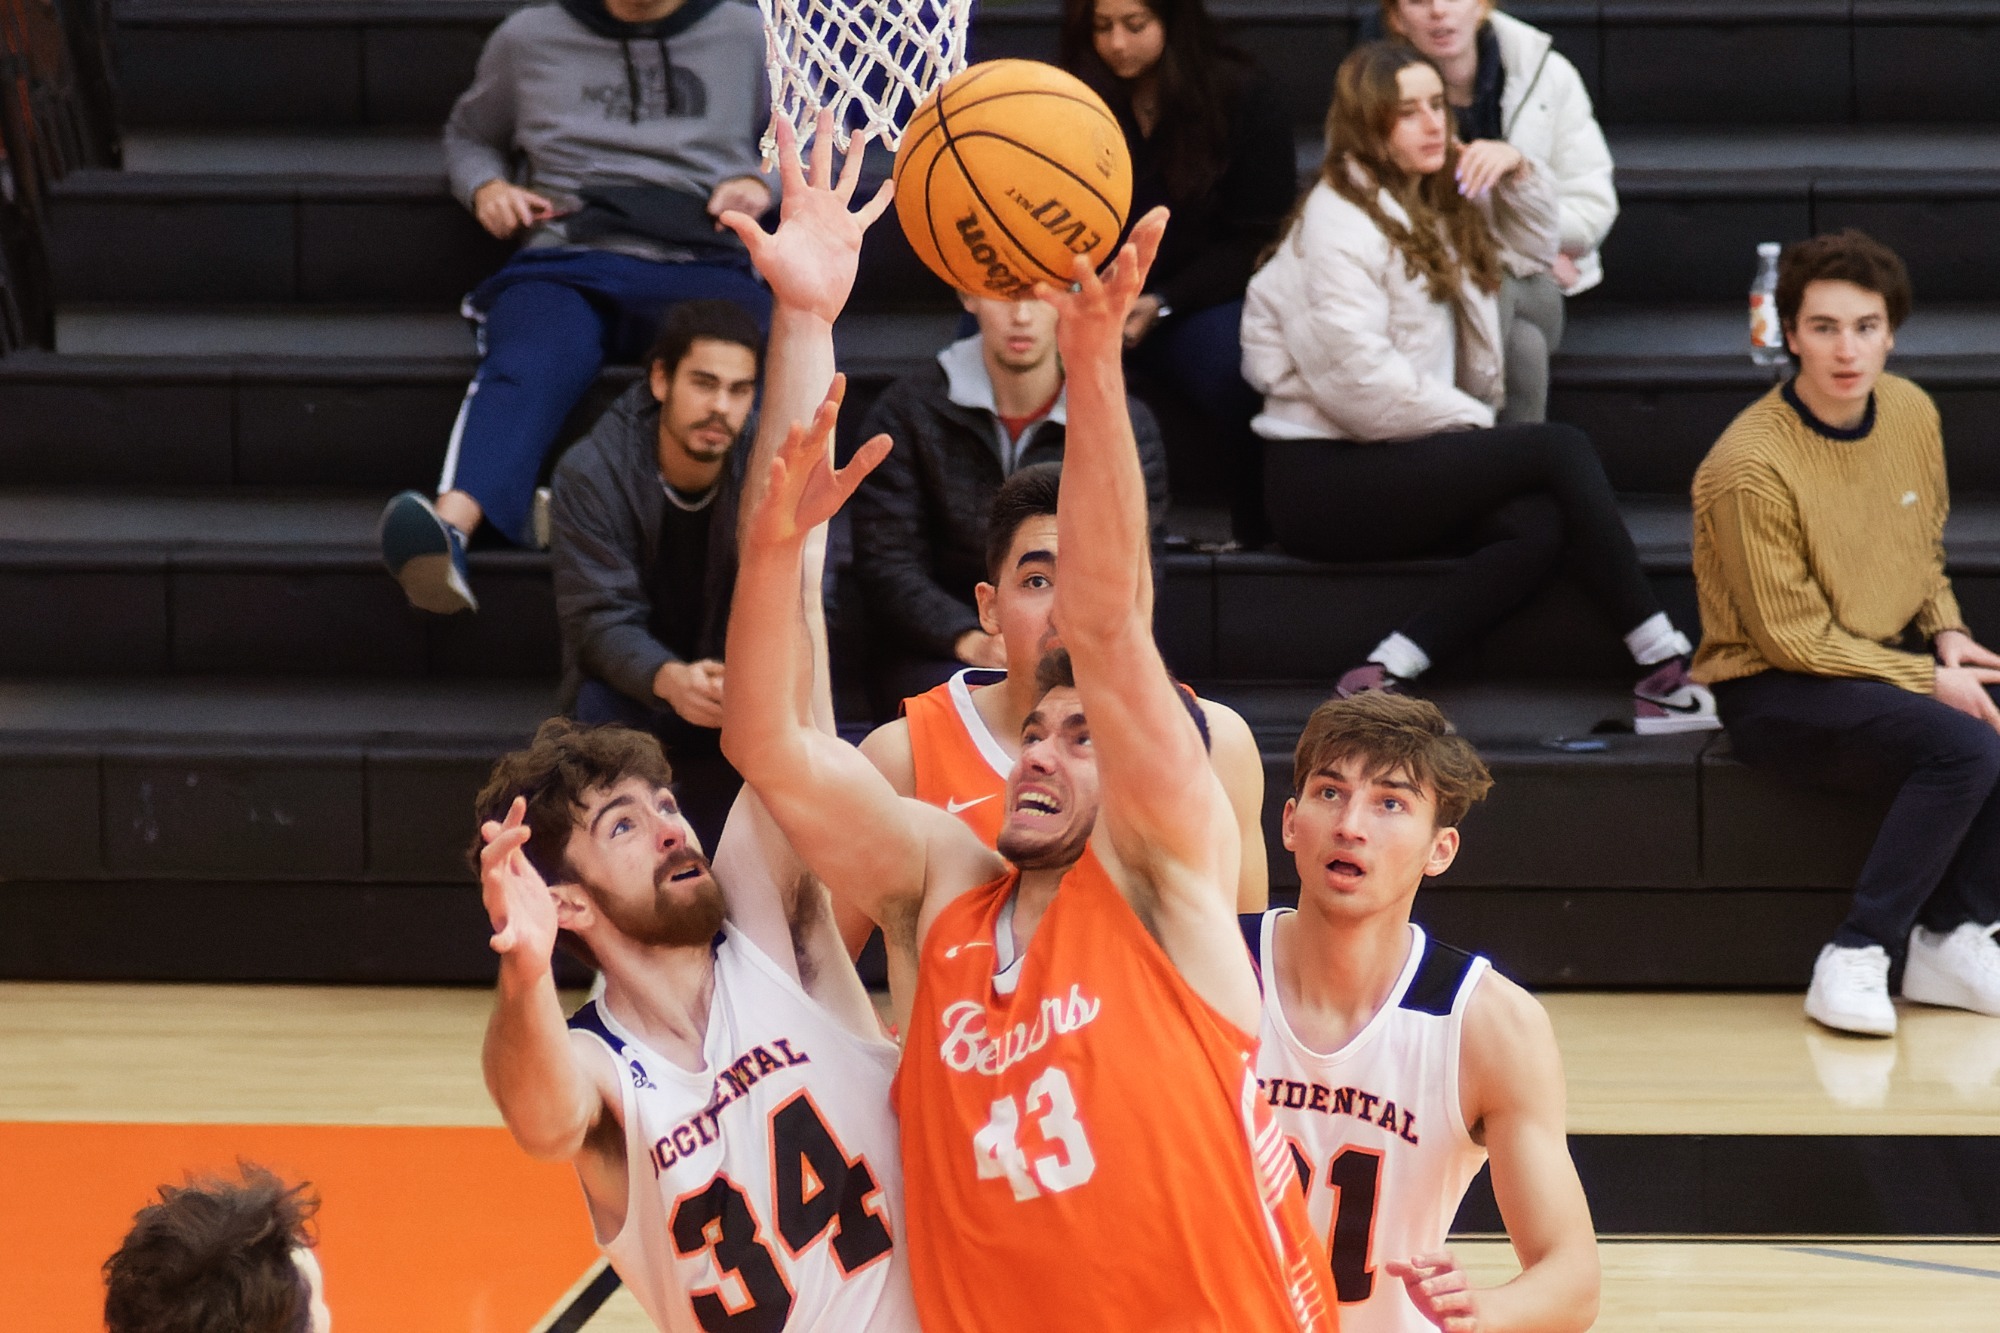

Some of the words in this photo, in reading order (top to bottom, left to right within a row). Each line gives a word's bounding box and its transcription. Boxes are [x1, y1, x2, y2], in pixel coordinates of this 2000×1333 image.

[956, 209, 1035, 298] ilson
[940, 983, 1100, 1076] Beavrs
[650, 1037, 811, 1180] CCINTAL
[973, 1066, 1096, 1202] 43
[1257, 1078, 1418, 1146] IDENTAL
[668, 1086, 894, 1333] 34
[1285, 1134, 1386, 1306] 1
